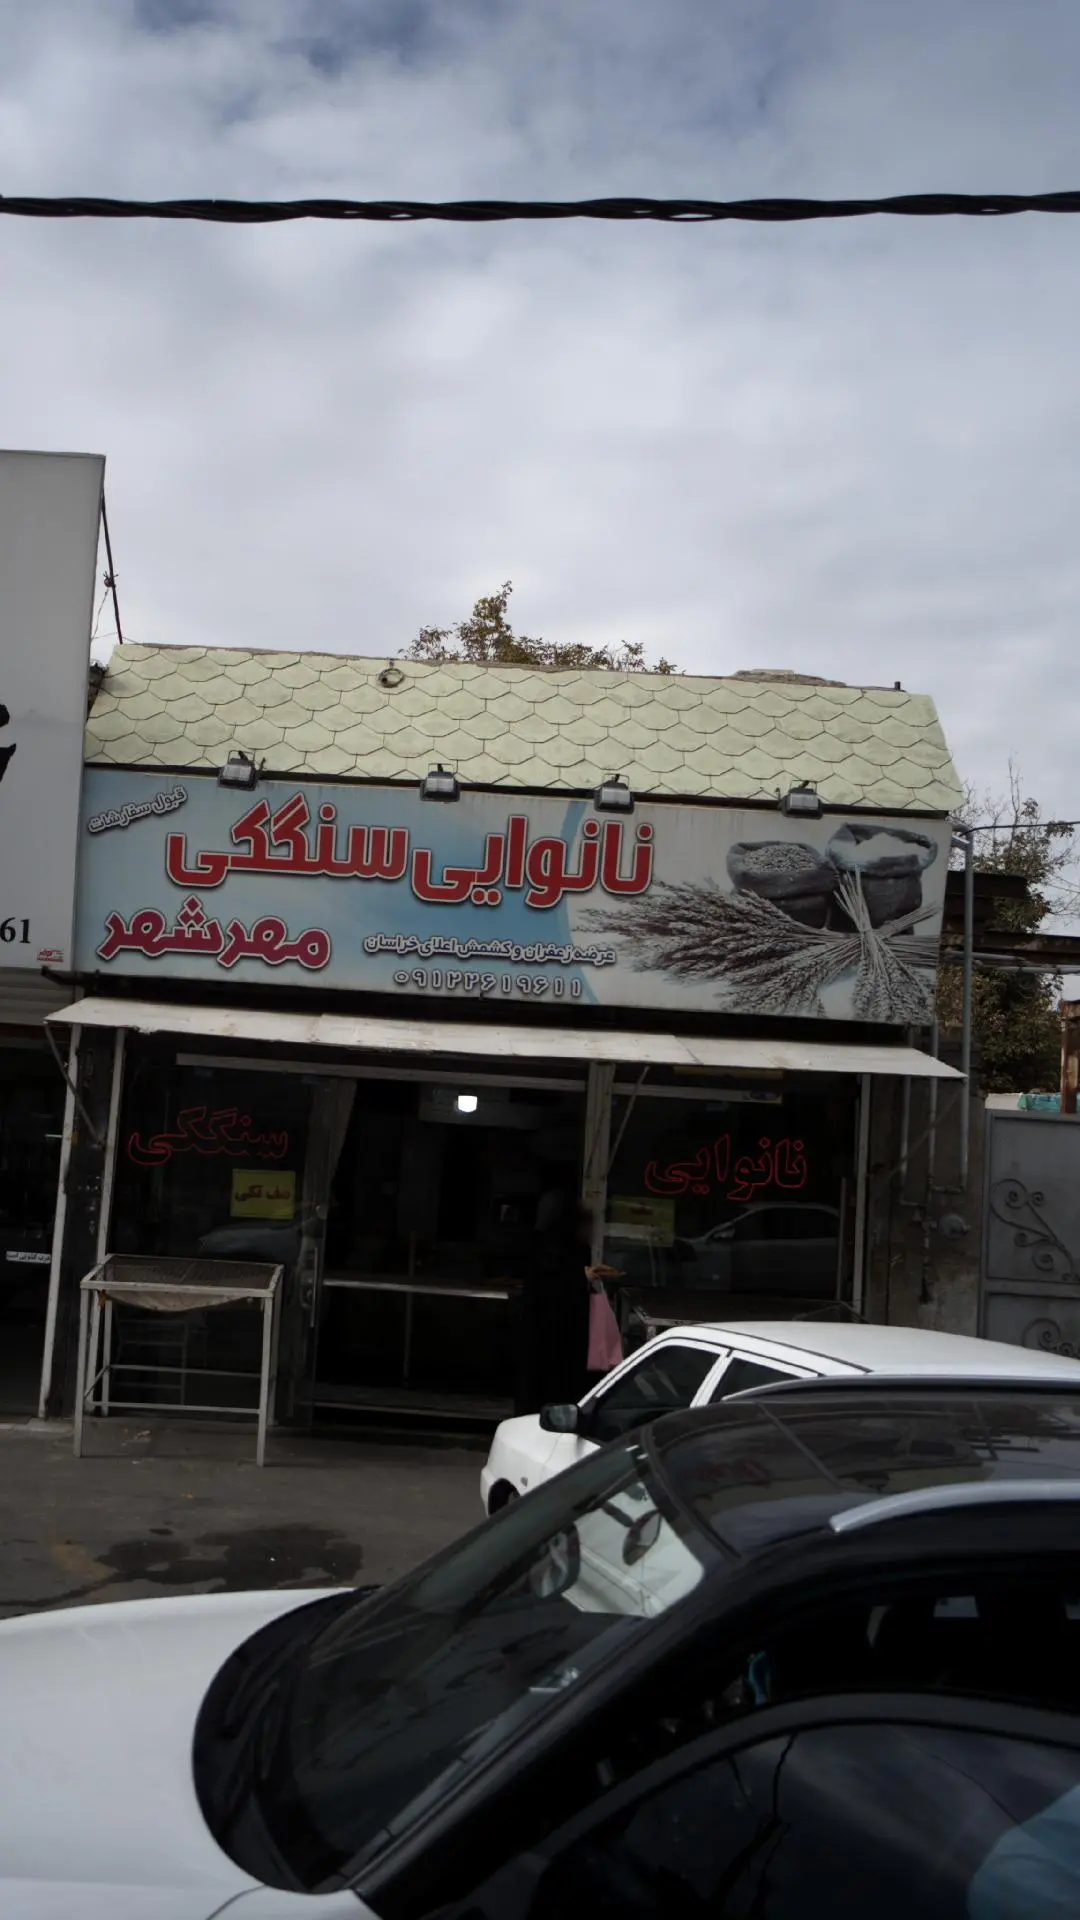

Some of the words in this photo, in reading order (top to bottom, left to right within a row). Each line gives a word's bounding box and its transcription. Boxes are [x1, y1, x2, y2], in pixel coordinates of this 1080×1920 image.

[151, 787, 188, 814] قبول
[88, 804, 152, 833] سفارشات
[166, 792, 409, 887] سنگکی
[412, 815, 654, 908] نانوایی
[97, 895, 332, 969] مهرشهر
[364, 934, 420, 954] خراسان
[456, 939, 512, 958] کشمش
[511, 945, 523, 961] و
[522, 943, 573, 964] زعفران
[572, 946, 616, 965] عرضه
[127, 1105, 288, 1167] سنگکی
[644, 1131, 808, 1200] نانوایی
